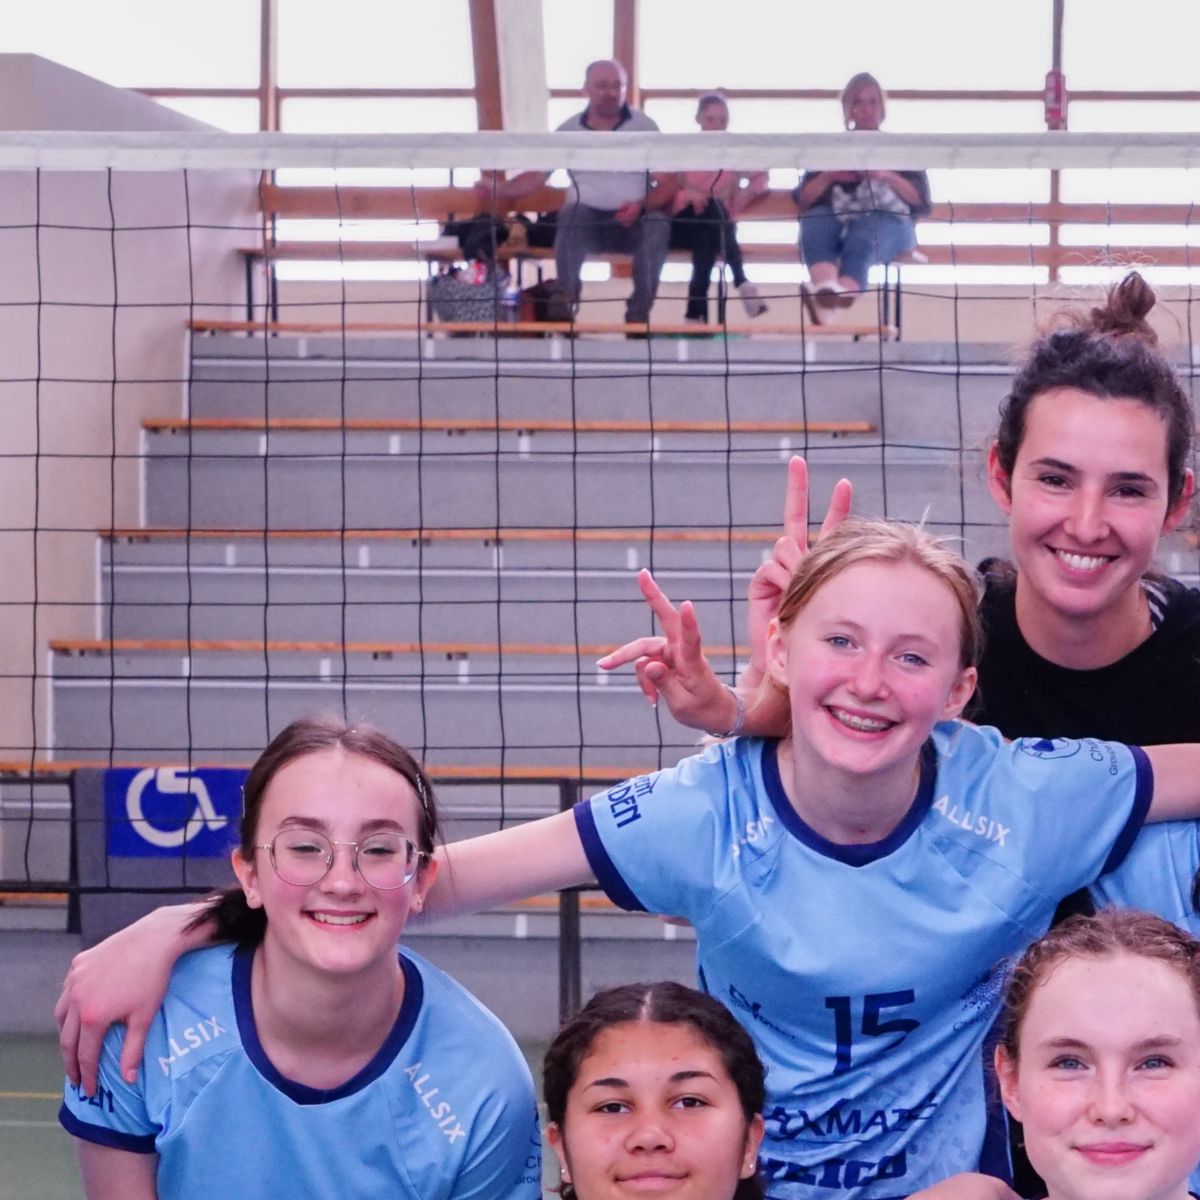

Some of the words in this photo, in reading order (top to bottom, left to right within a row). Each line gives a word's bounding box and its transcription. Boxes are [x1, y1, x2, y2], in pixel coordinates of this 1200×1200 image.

[932, 794, 1011, 847] ALLSIX
[825, 989, 920, 1074] 15
[403, 1062, 466, 1144] ALLSIX
